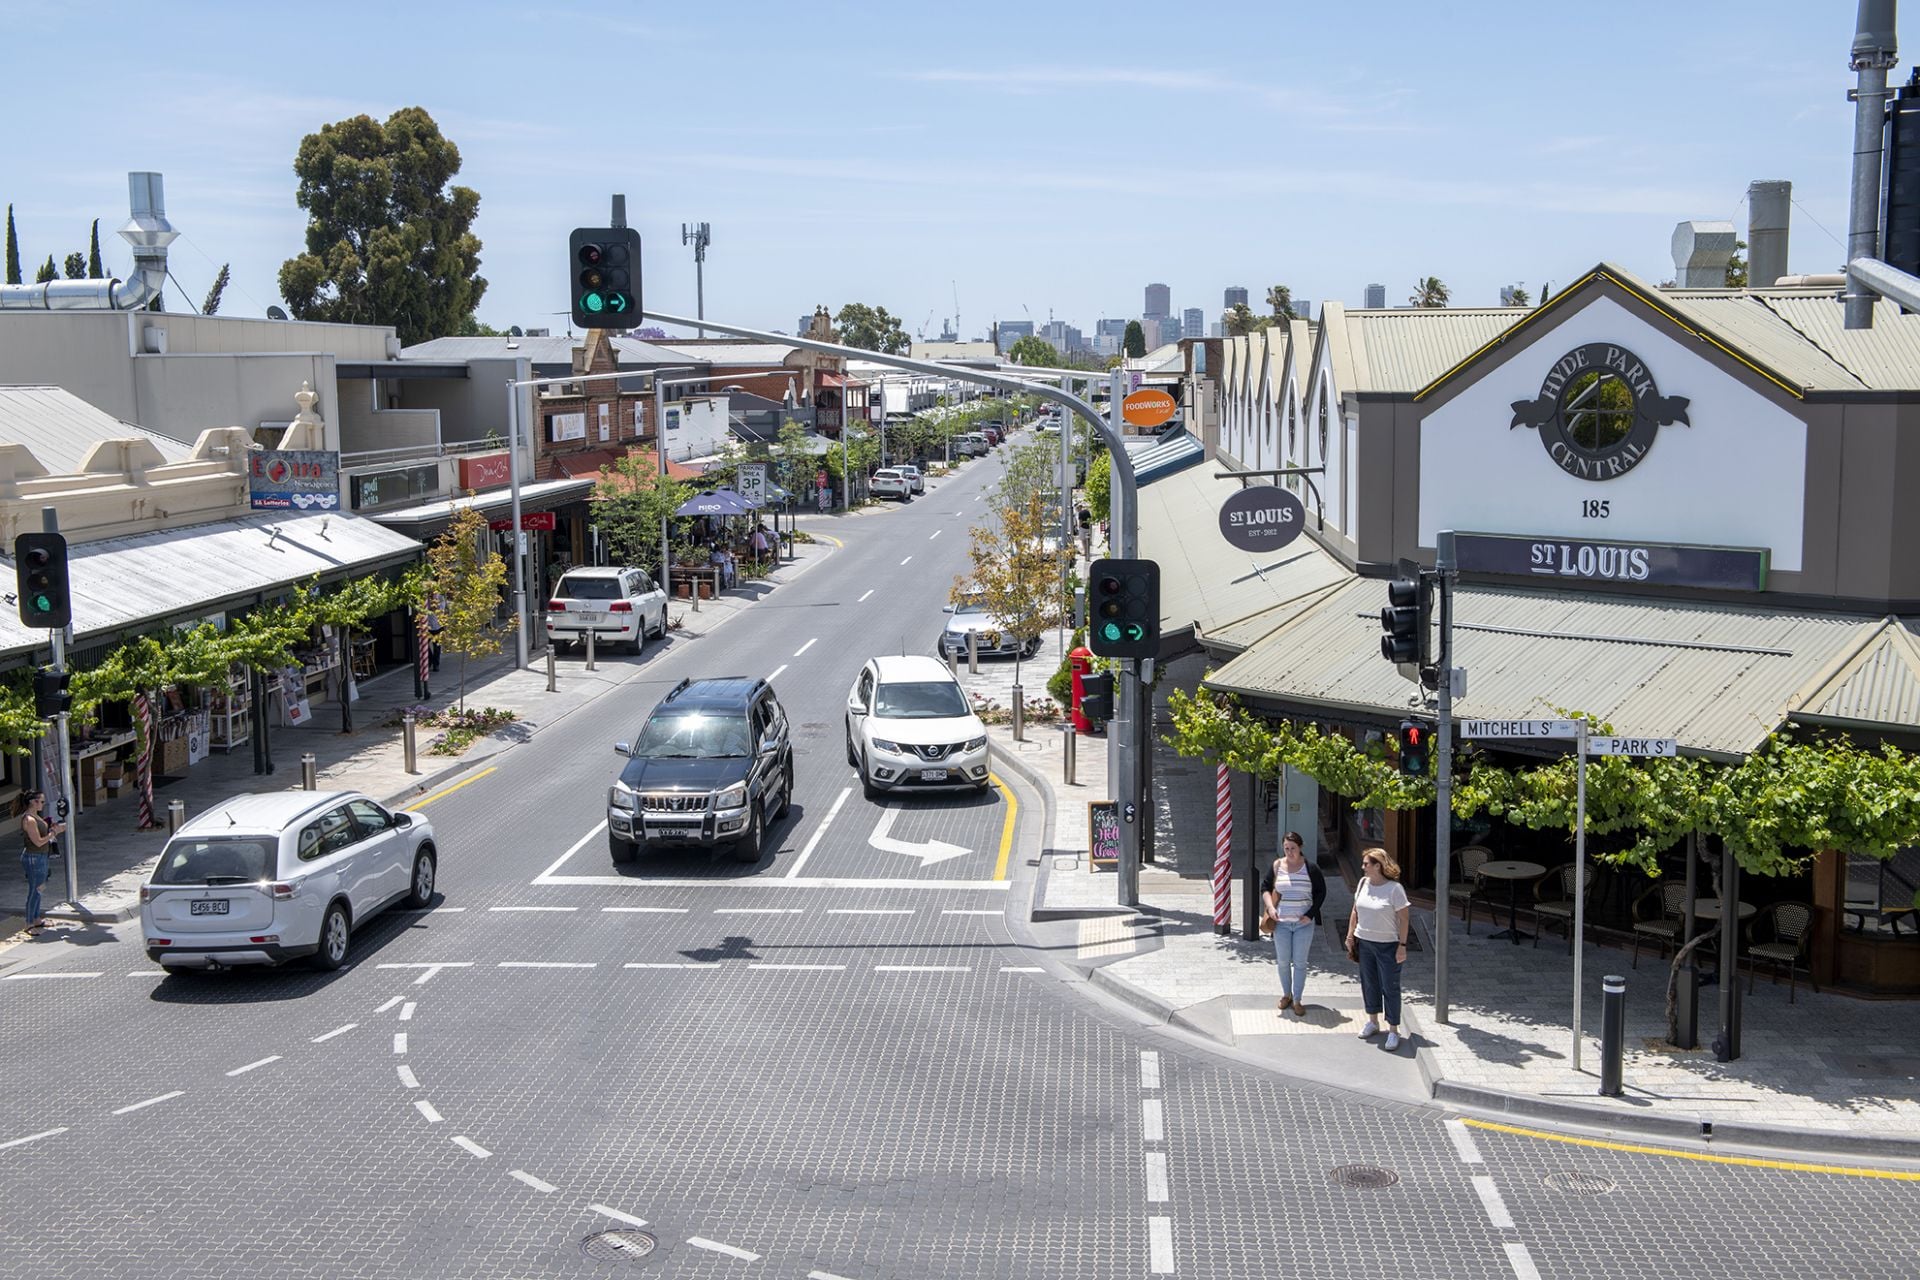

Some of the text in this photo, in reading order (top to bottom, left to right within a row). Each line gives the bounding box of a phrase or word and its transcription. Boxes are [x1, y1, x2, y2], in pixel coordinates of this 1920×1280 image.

[1541, 346, 1654, 400] HYDE PARK
[1551, 441, 1646, 479] CENTRAL
[743, 478, 761, 489] 3P
[1230, 507, 1293, 526] ST LOUIS
[1582, 500, 1610, 518] 185
[1531, 543, 1650, 580] ST LOUIS
[1467, 722, 1535, 736] MITCHELL
[1611, 739, 1649, 753] PARK
